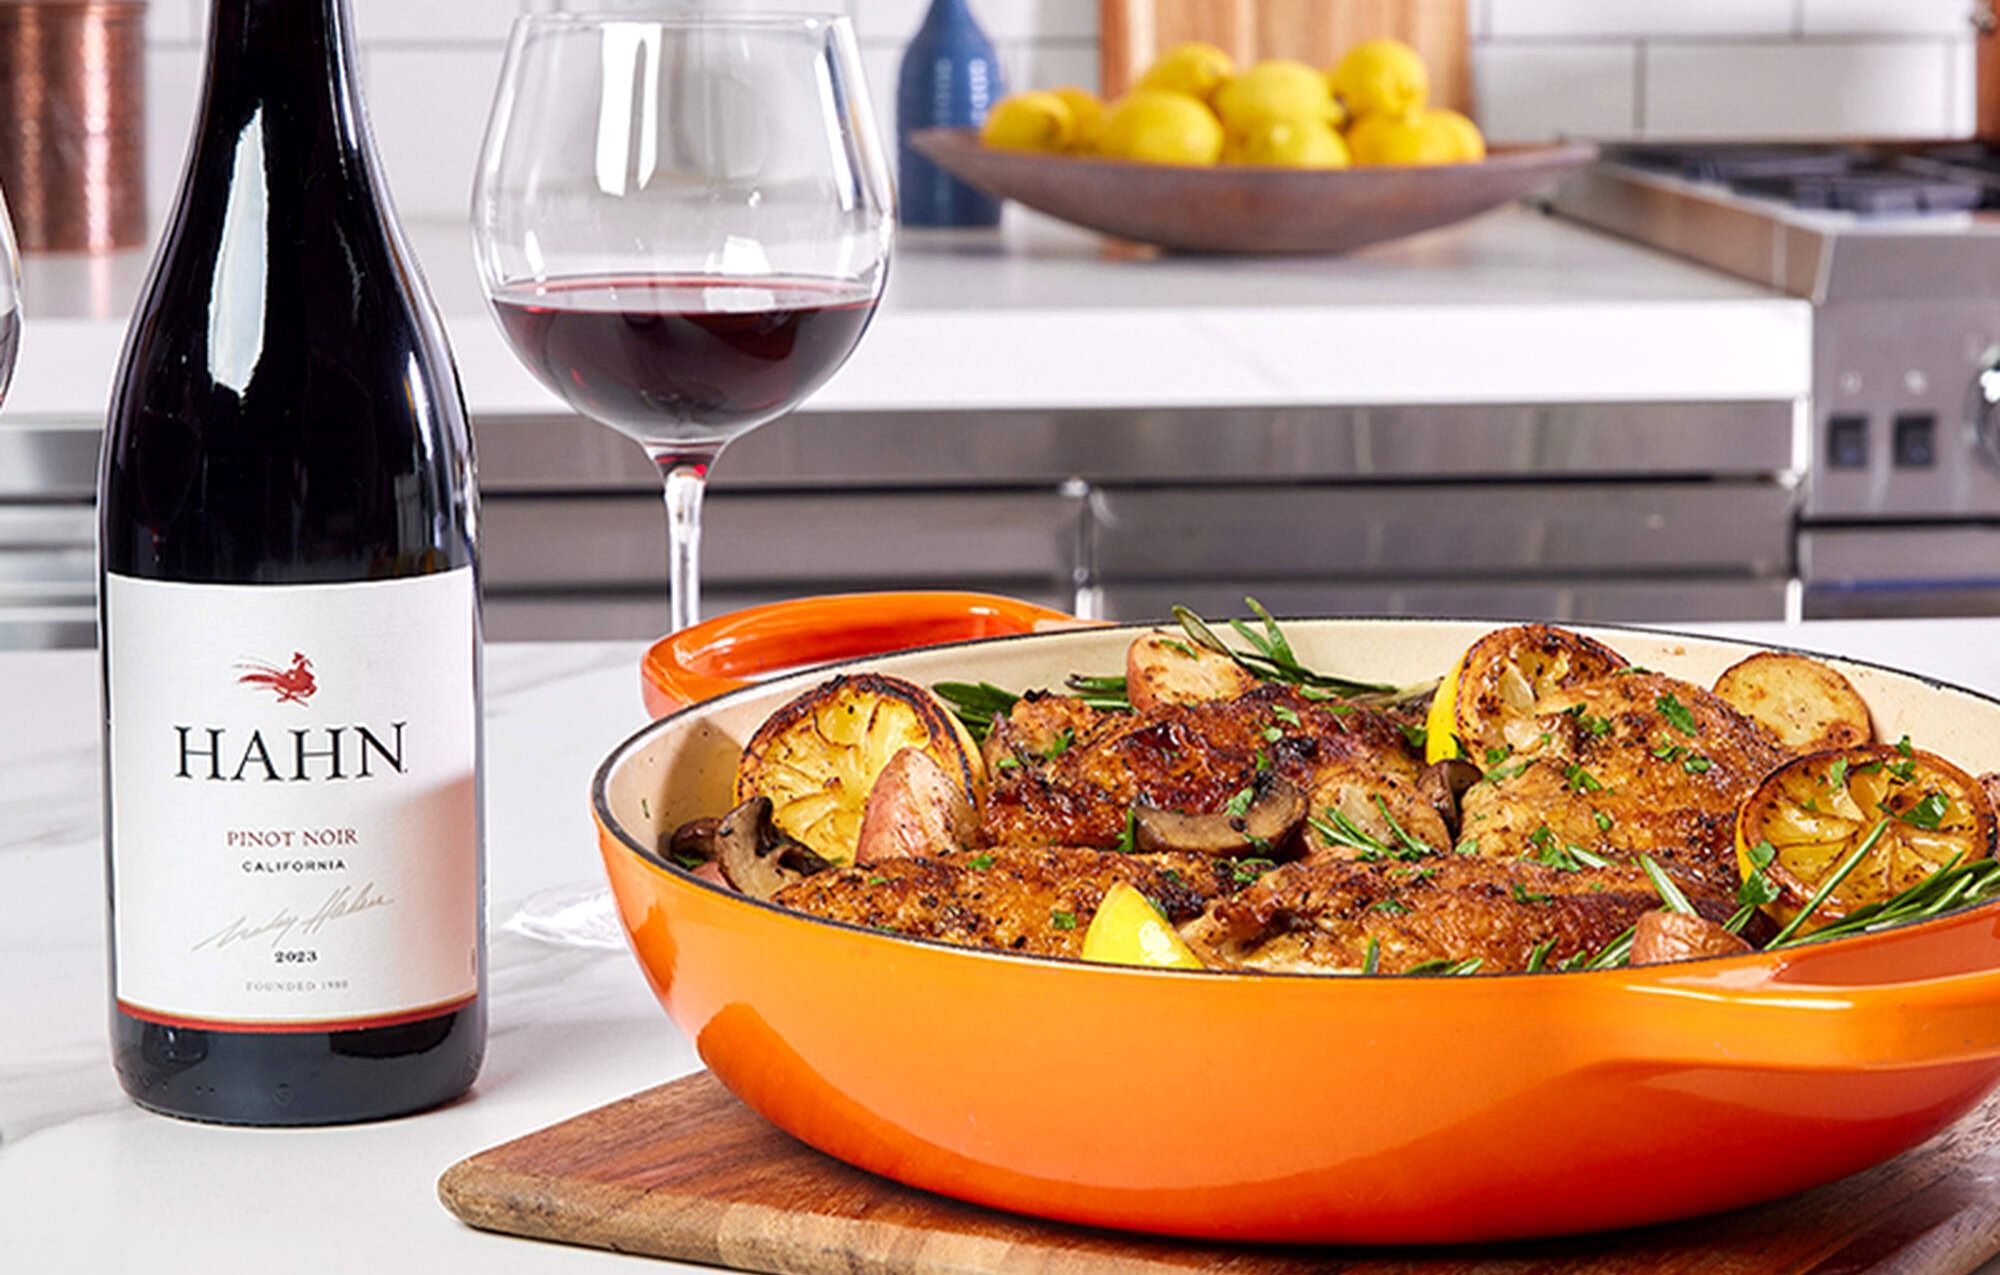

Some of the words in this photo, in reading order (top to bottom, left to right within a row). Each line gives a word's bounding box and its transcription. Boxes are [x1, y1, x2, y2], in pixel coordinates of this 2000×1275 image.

[227, 830, 295, 848] PINOT
[304, 828, 358, 847] NOIR
[242, 860, 346, 873] CALIFORNIA
[274, 950, 318, 963] 2023
[246, 981, 316, 991] FOUNDED
